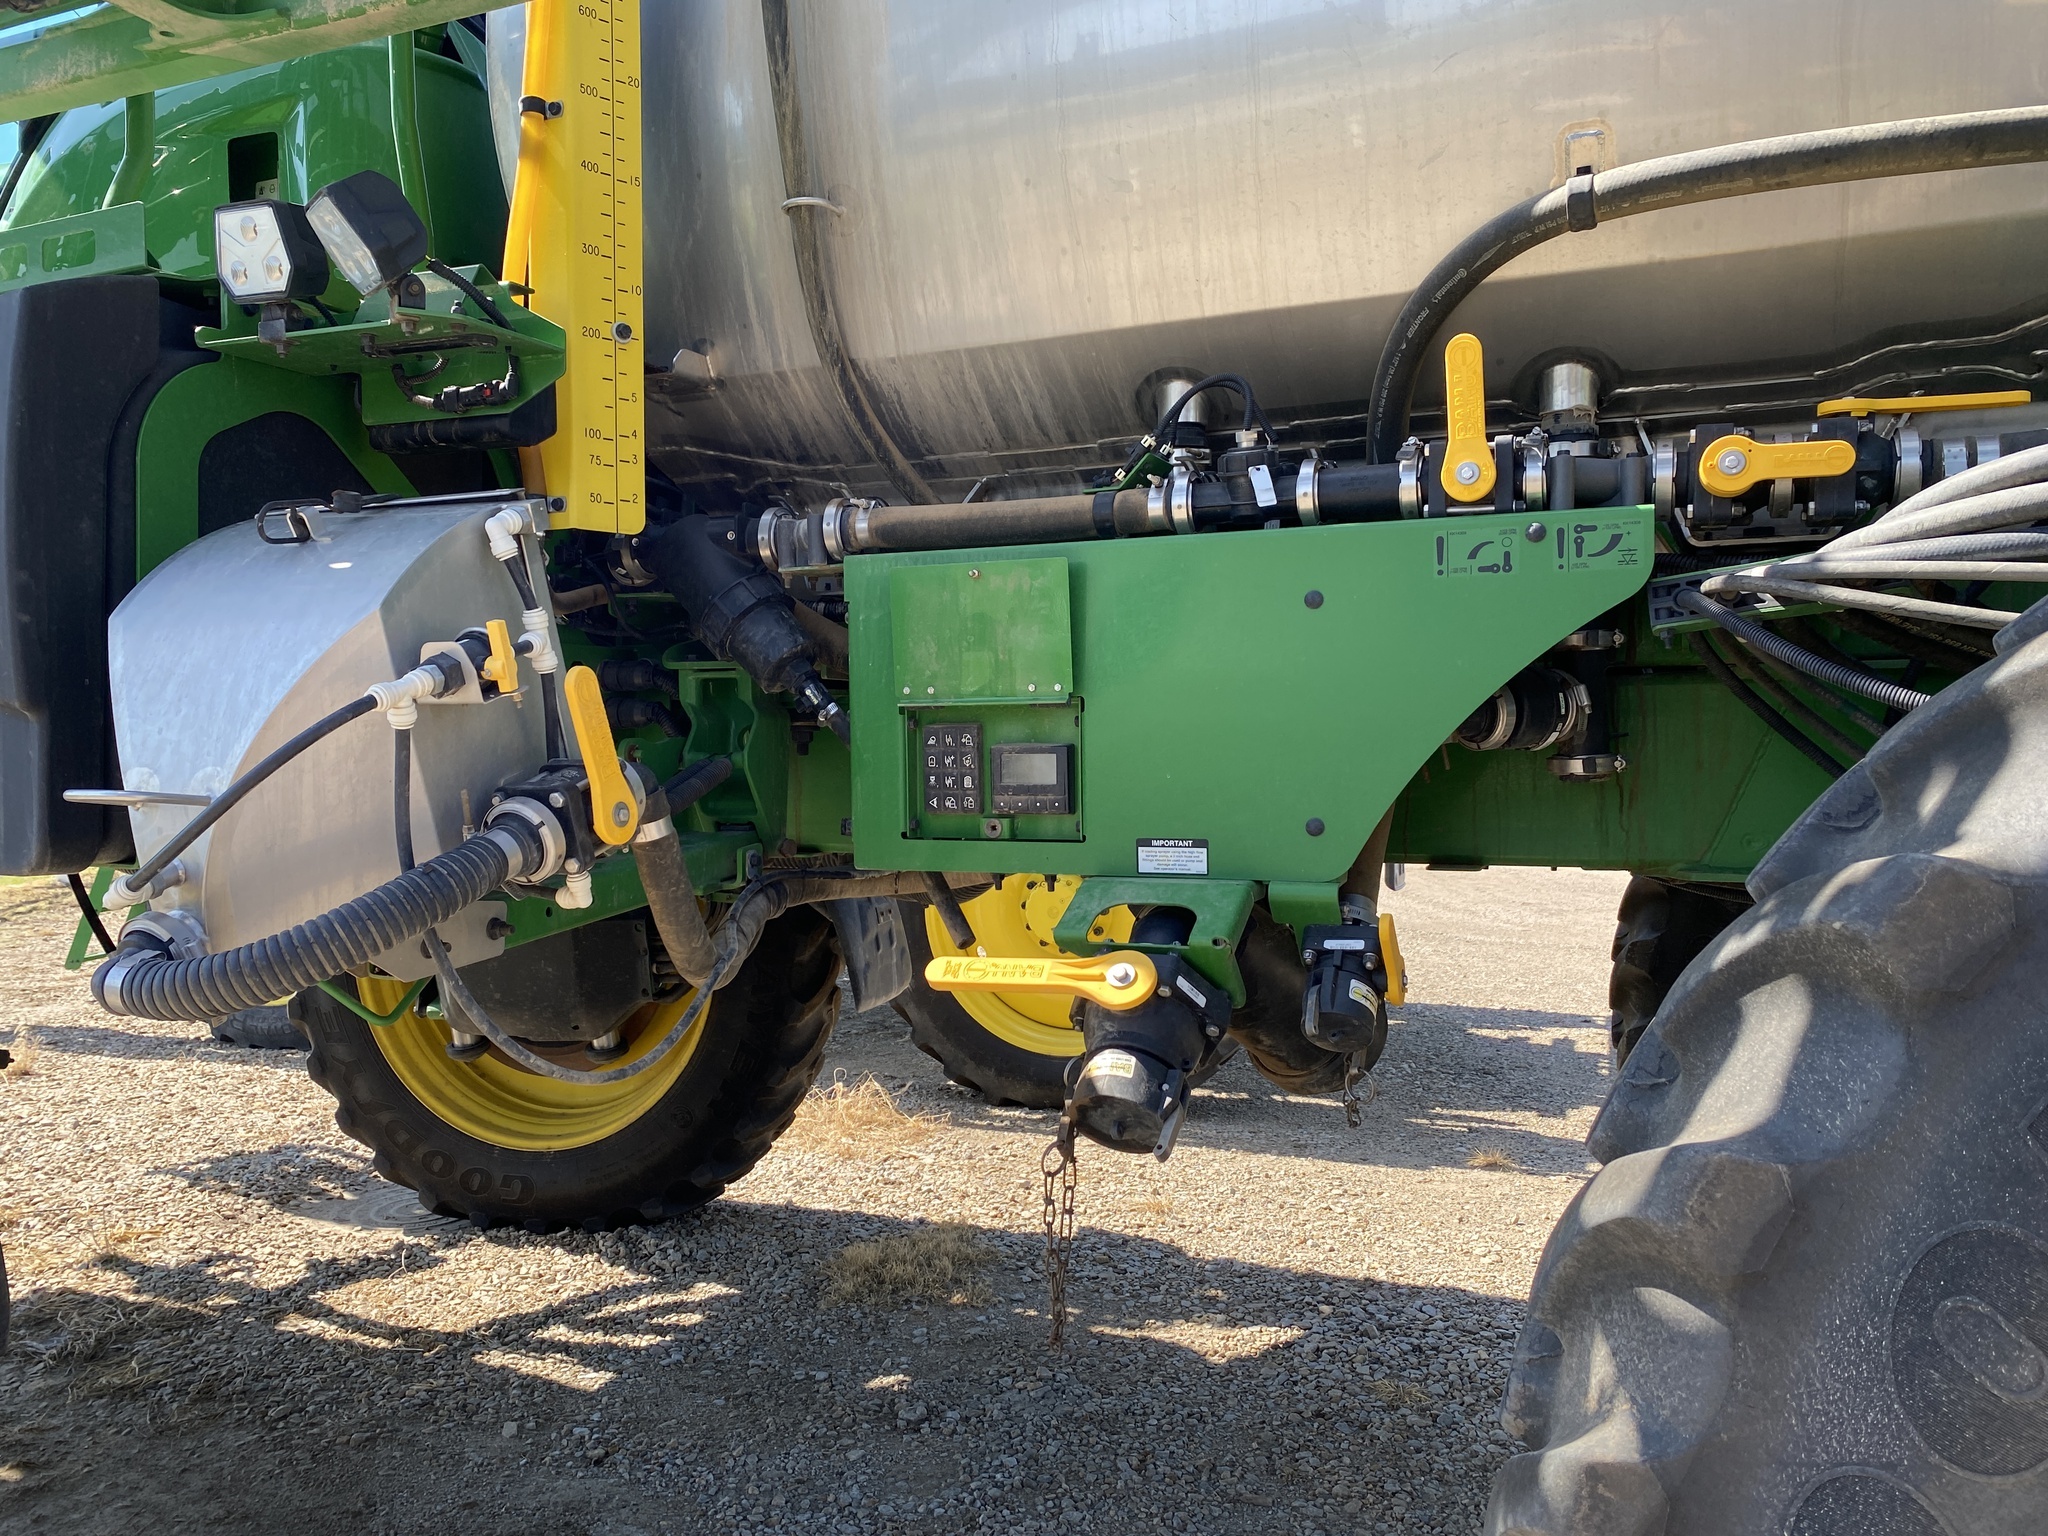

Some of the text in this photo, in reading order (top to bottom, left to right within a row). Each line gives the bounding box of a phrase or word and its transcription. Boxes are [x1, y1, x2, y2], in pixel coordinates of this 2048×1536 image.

[578, 5, 597, 19] 600
[628, 76, 640, 88] 20
[580, 84, 598, 97] 500
[581, 160, 599, 173] 400
[629, 176, 640, 187] 15
[582, 244, 599, 256] 300
[1434, 267, 1468, 301] Continental
[631, 285, 642, 296] 10
[1407, 307, 1430, 338] FRONTIER
[582, 327, 601, 339] 200
[631, 393, 637, 403] 5
[584, 428, 601, 440] 100
[632, 431, 637, 439] 4
[590, 455, 601, 465] 75
[632, 455, 638, 465] 3
[590, 494, 602, 503] 50
[632, 495, 638, 504] 2
